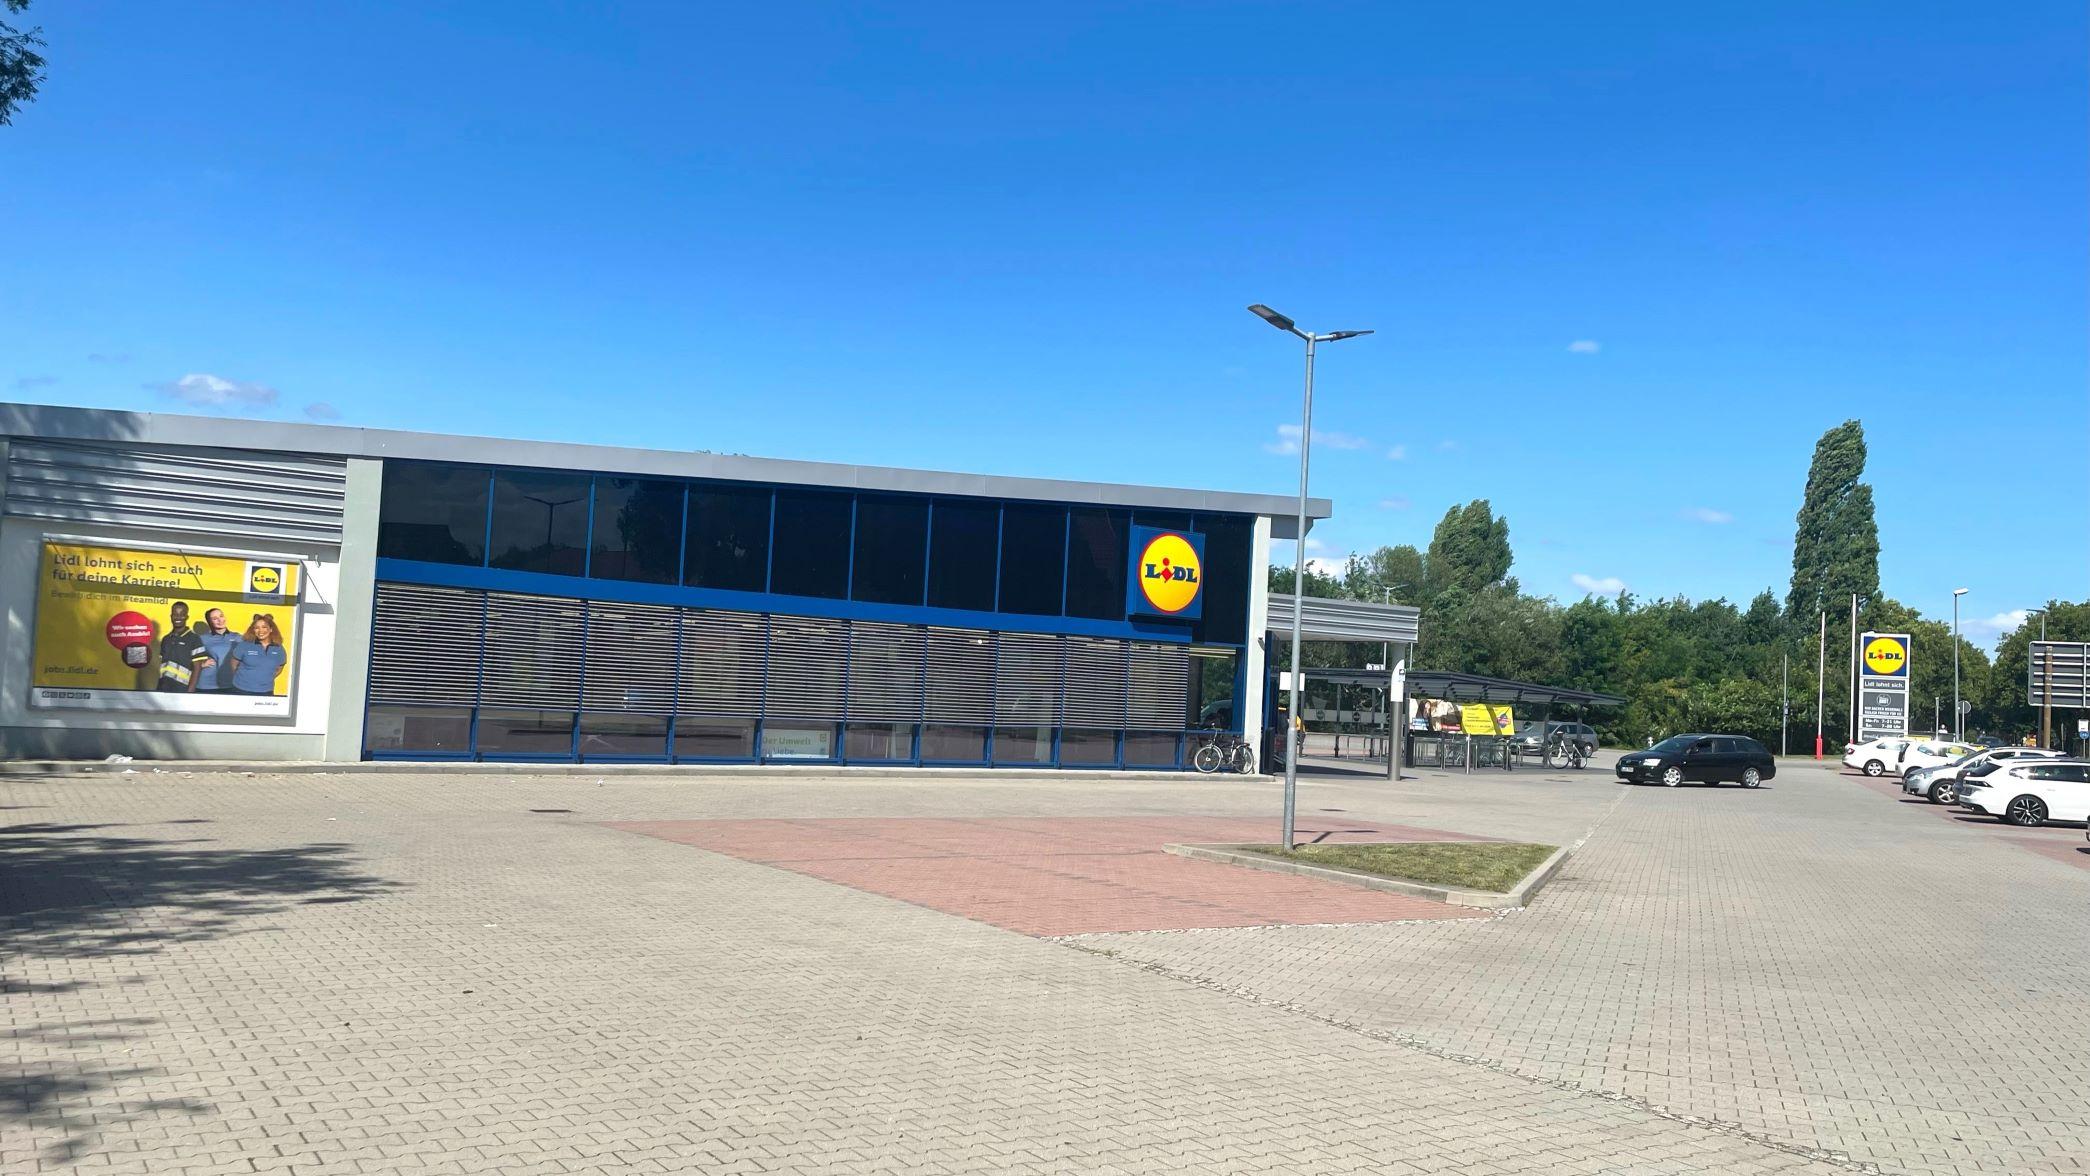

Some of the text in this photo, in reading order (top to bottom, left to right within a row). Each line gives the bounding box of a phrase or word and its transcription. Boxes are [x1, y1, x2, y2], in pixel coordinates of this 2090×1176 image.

[54, 554, 80, 566] Lidl
[85, 556, 122, 569] lohnt
[126, 560, 154, 571] sich
[171, 565, 203, 575] auch
[77, 571, 117, 584] deine
[122, 575, 181, 588] Karriere!
